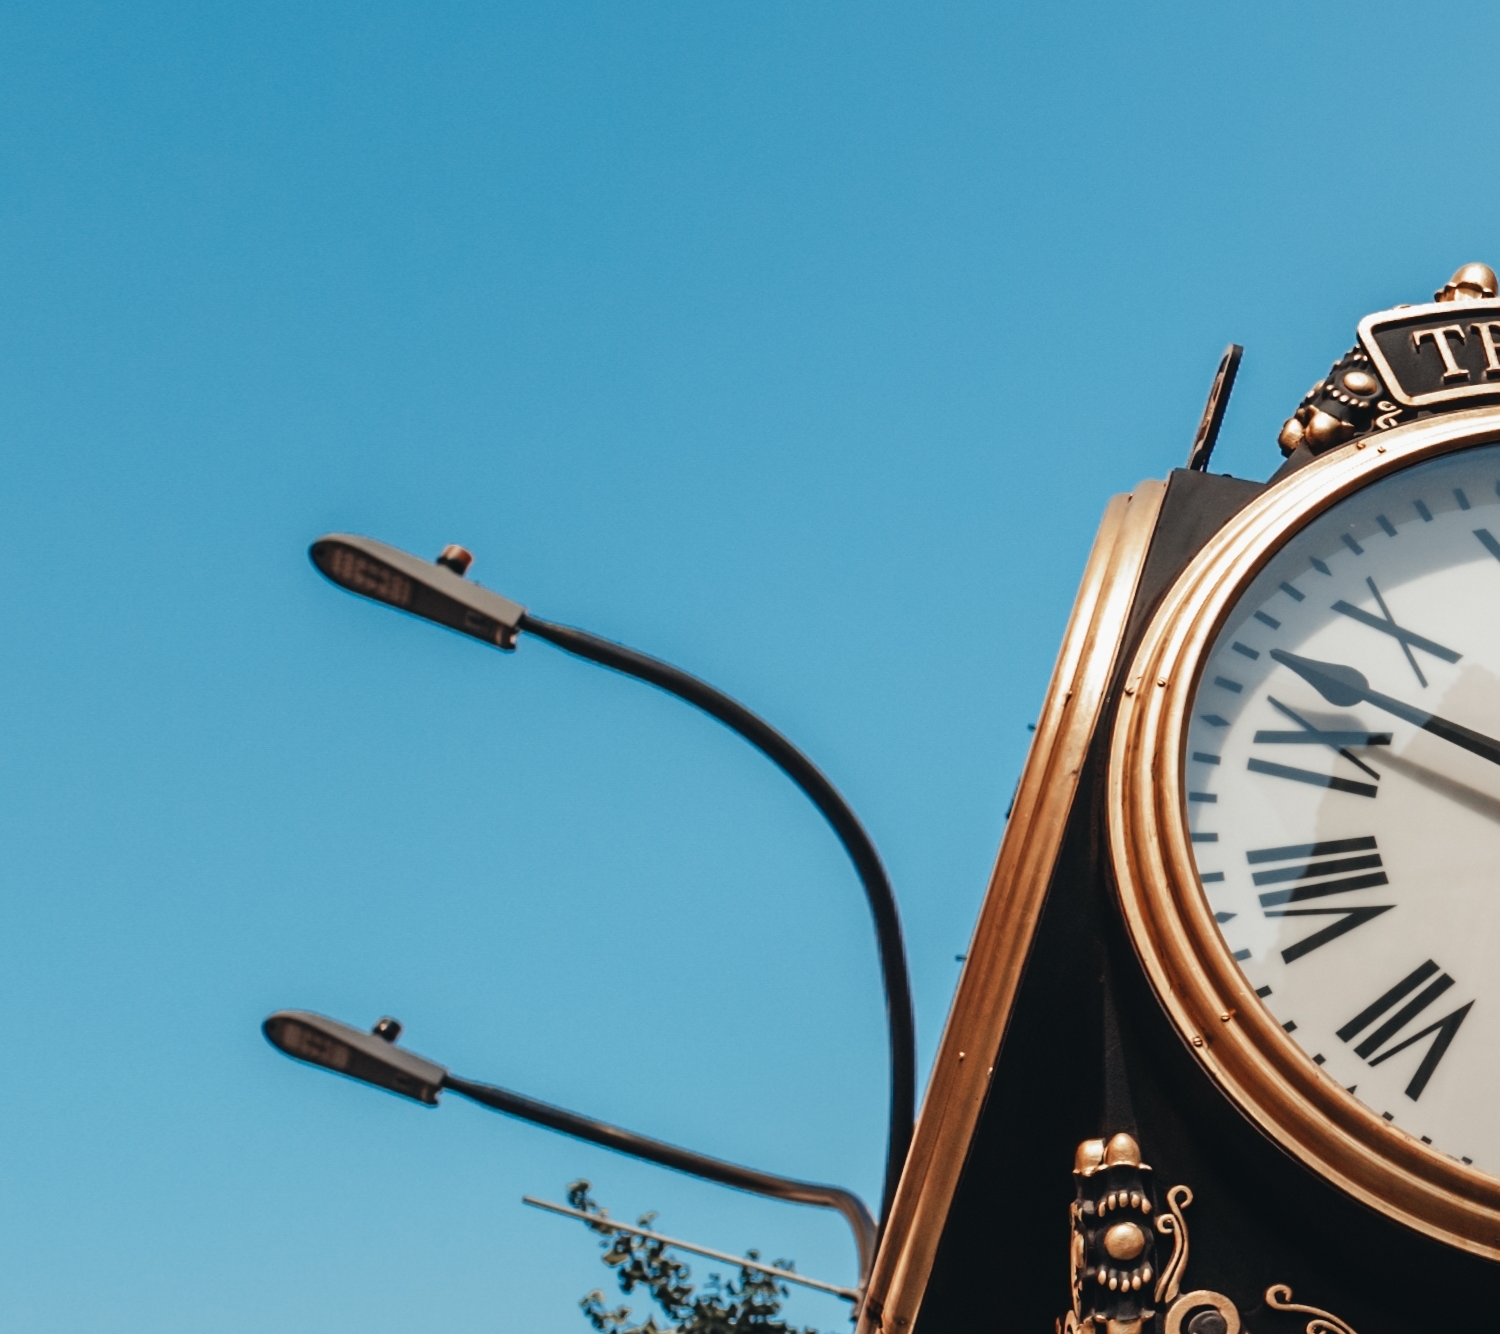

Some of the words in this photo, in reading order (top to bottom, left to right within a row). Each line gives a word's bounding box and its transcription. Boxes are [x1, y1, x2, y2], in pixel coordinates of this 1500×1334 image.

[1333, 576, 1462, 688] X
[1247, 695, 1393, 798] IX
[1246, 835, 1397, 964] VIII
[1336, 958, 1476, 1100] VII
